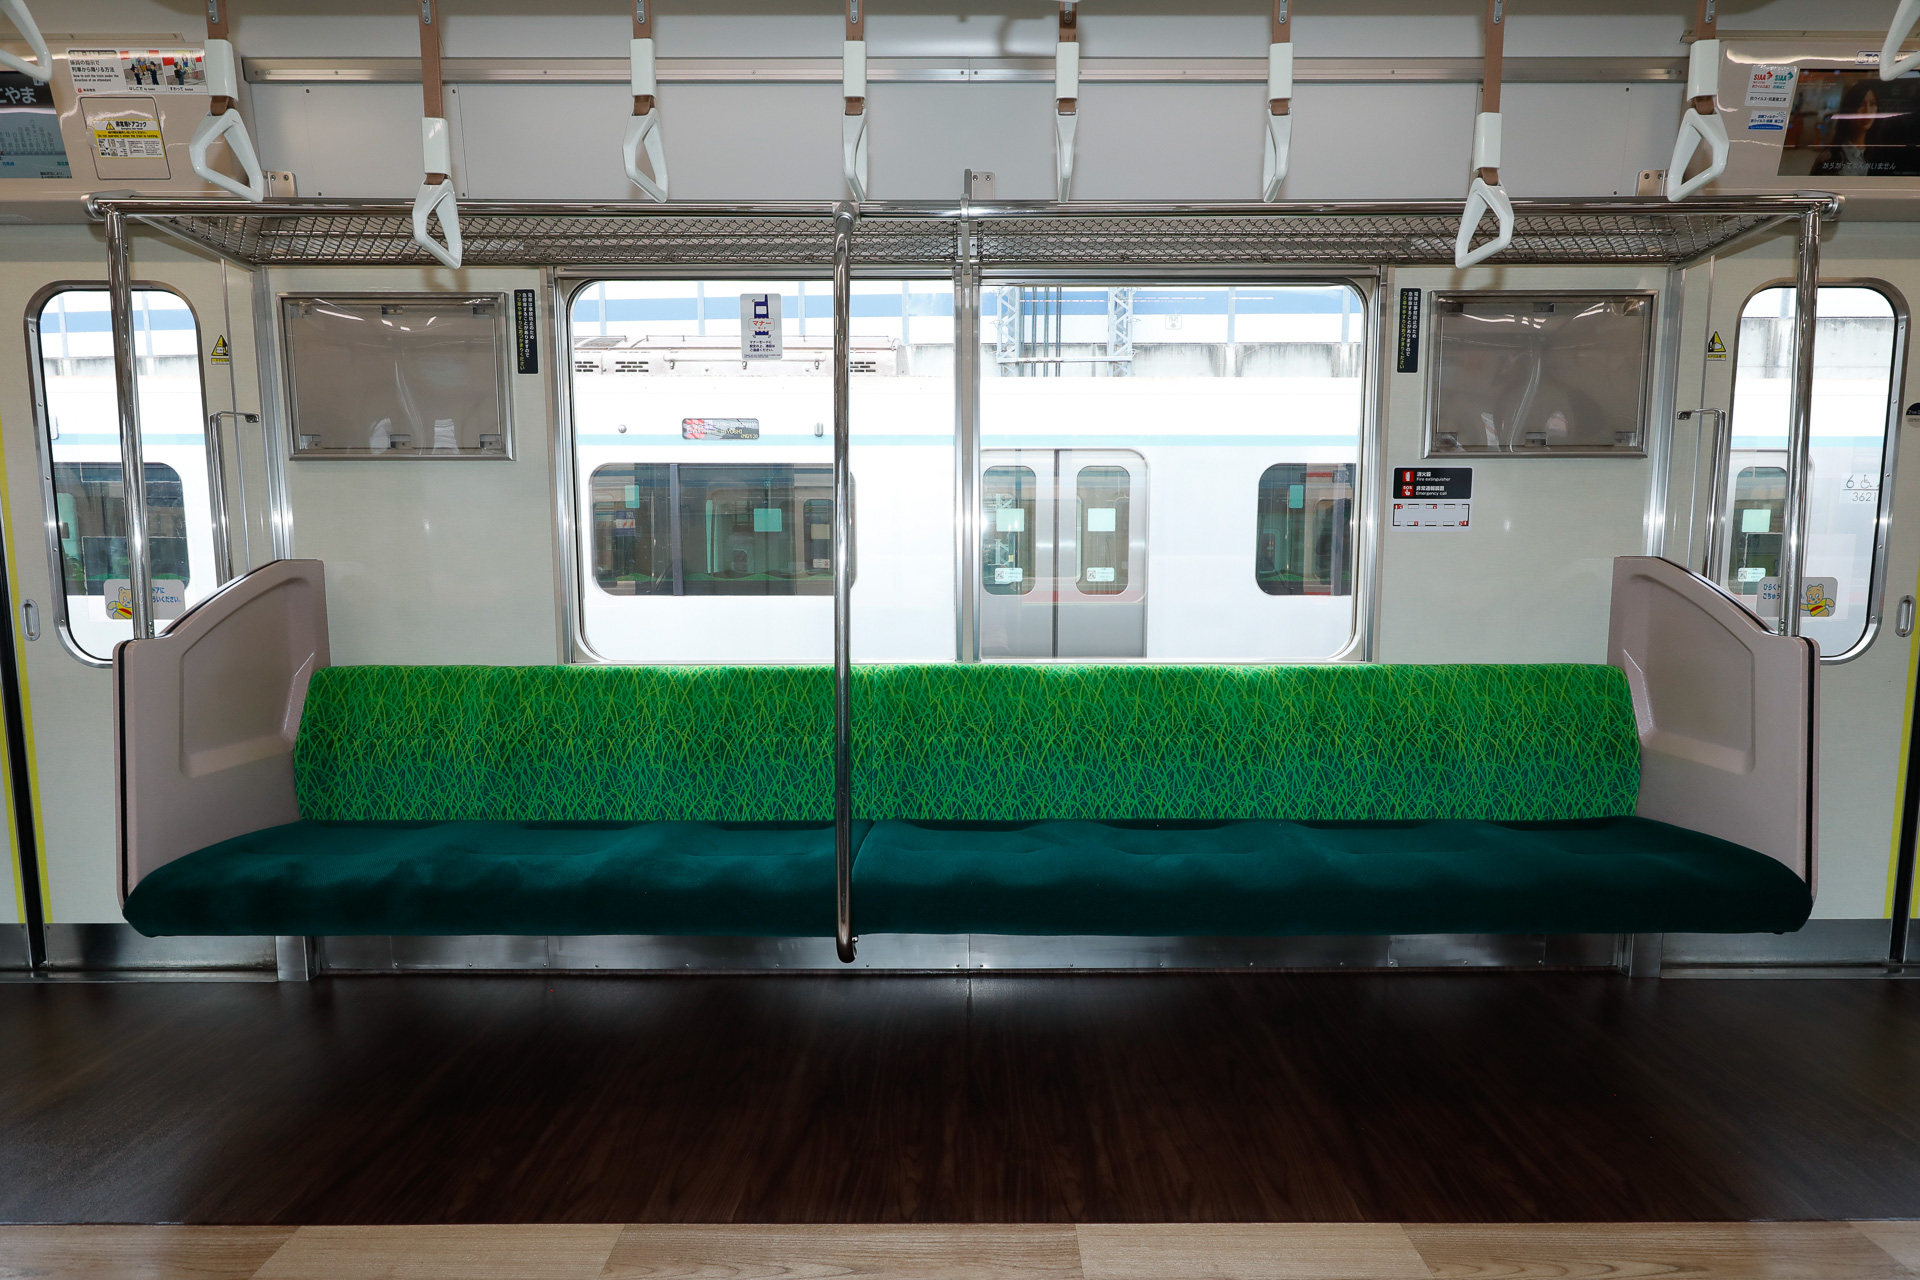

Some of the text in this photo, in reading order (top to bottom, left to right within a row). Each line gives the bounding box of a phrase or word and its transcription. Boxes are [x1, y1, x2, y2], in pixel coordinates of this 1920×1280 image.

[1753, 73, 1767, 81] SIAA
[1774, 74, 1787, 82] SIAA
[1846, 474, 1855, 489] 6
